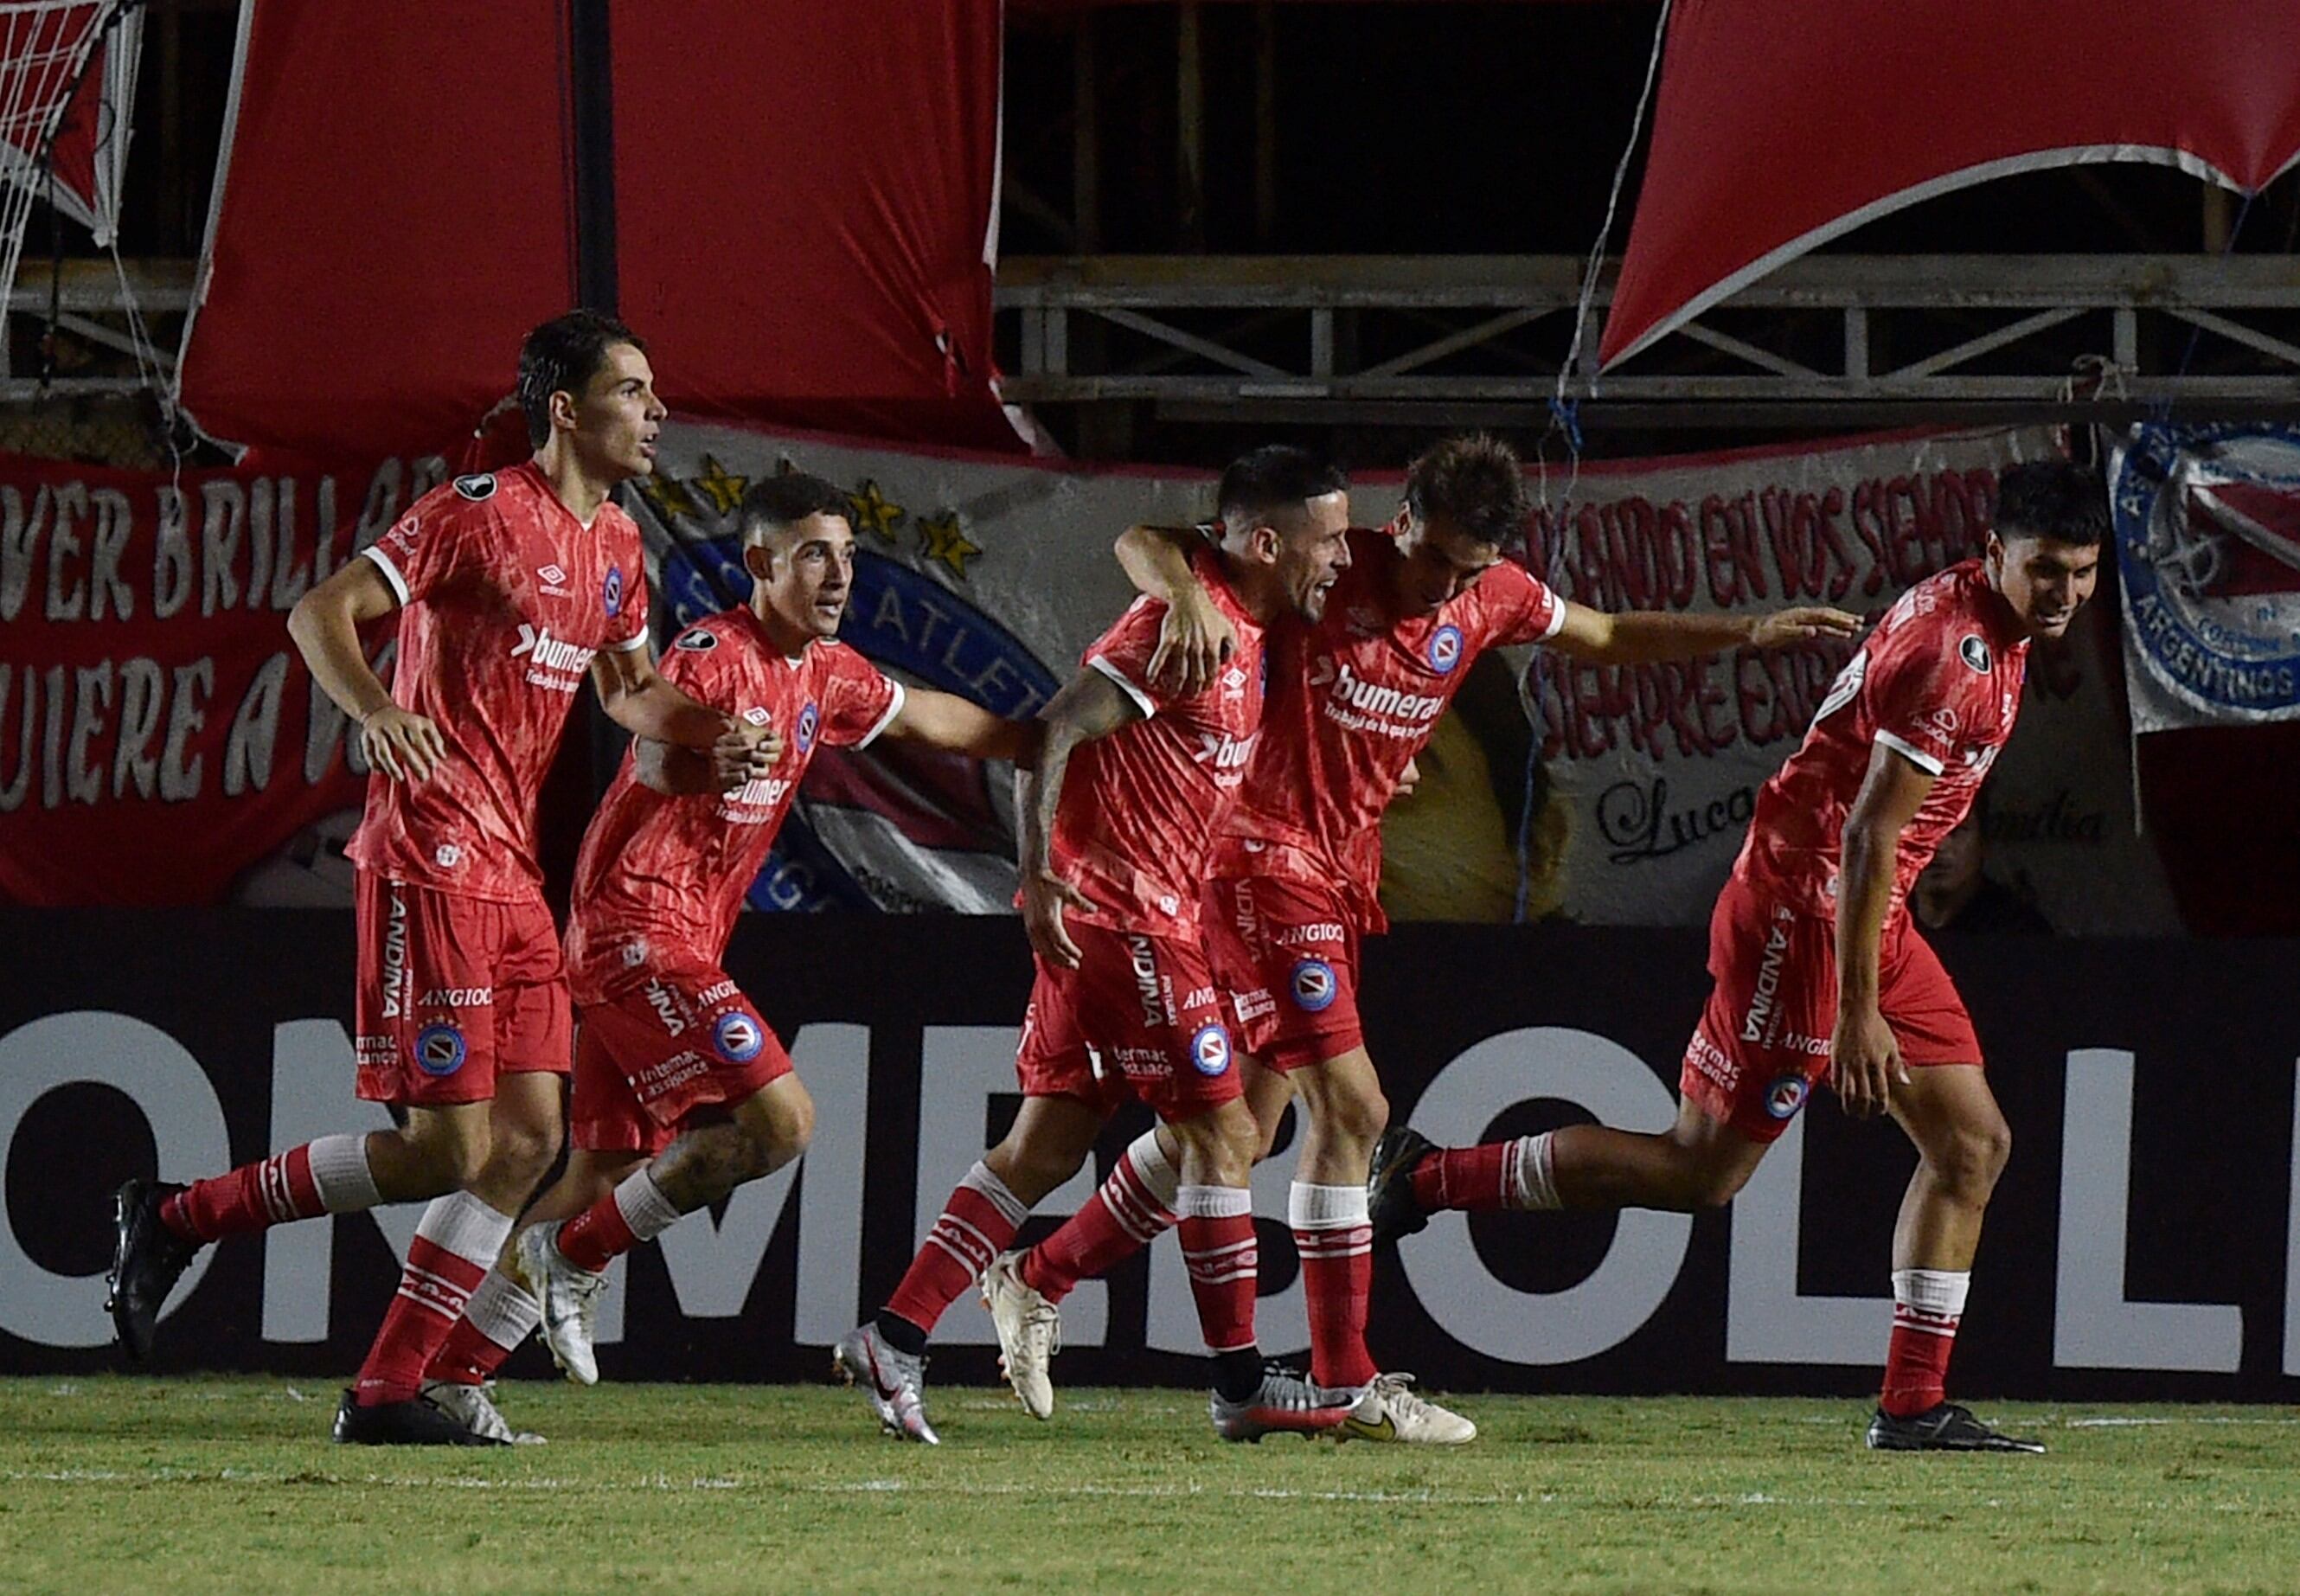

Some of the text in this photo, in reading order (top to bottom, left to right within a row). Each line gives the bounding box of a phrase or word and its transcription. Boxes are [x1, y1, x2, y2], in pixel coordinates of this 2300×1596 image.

[222, 650, 291, 798] A
[381, 894, 407, 1019] ANDINA
[1739, 924, 1788, 1042] ANDINA
[2052, 1047, 2300, 1375] L
